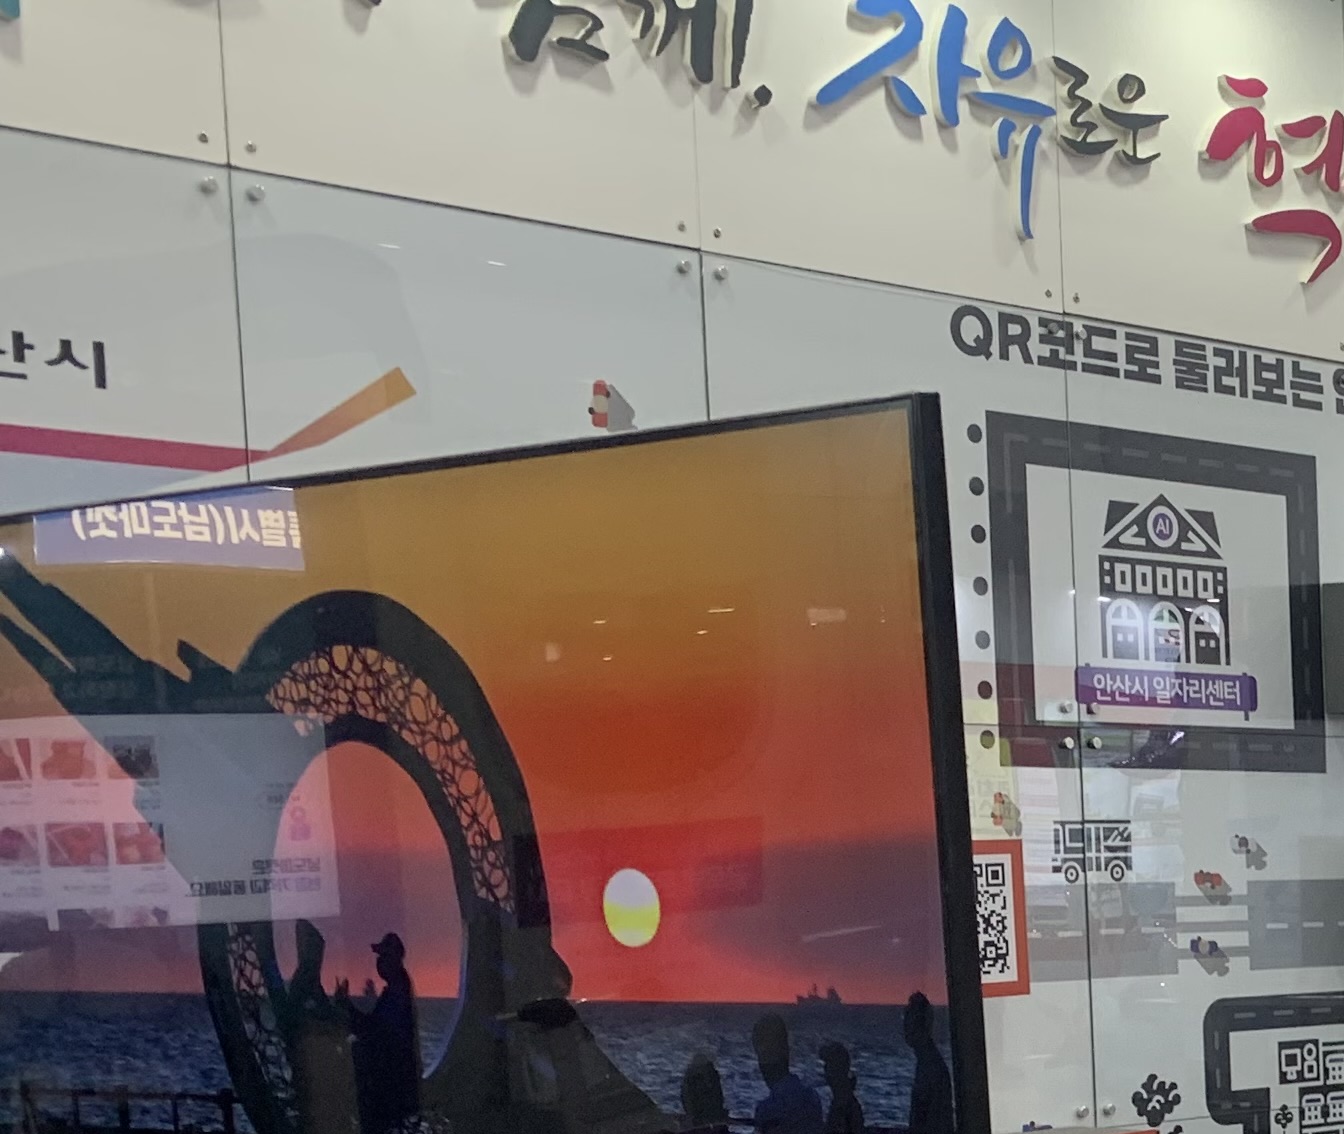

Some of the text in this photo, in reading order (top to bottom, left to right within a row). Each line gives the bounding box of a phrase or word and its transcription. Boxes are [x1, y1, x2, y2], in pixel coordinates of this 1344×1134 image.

[813, 0, 1169, 240] 자유로운
[949, 304, 1163, 385] QR코드로
[1172, 339, 1325, 412] 둘러보는
[1093, 673, 1241, 706] 안산시 일자리센터
